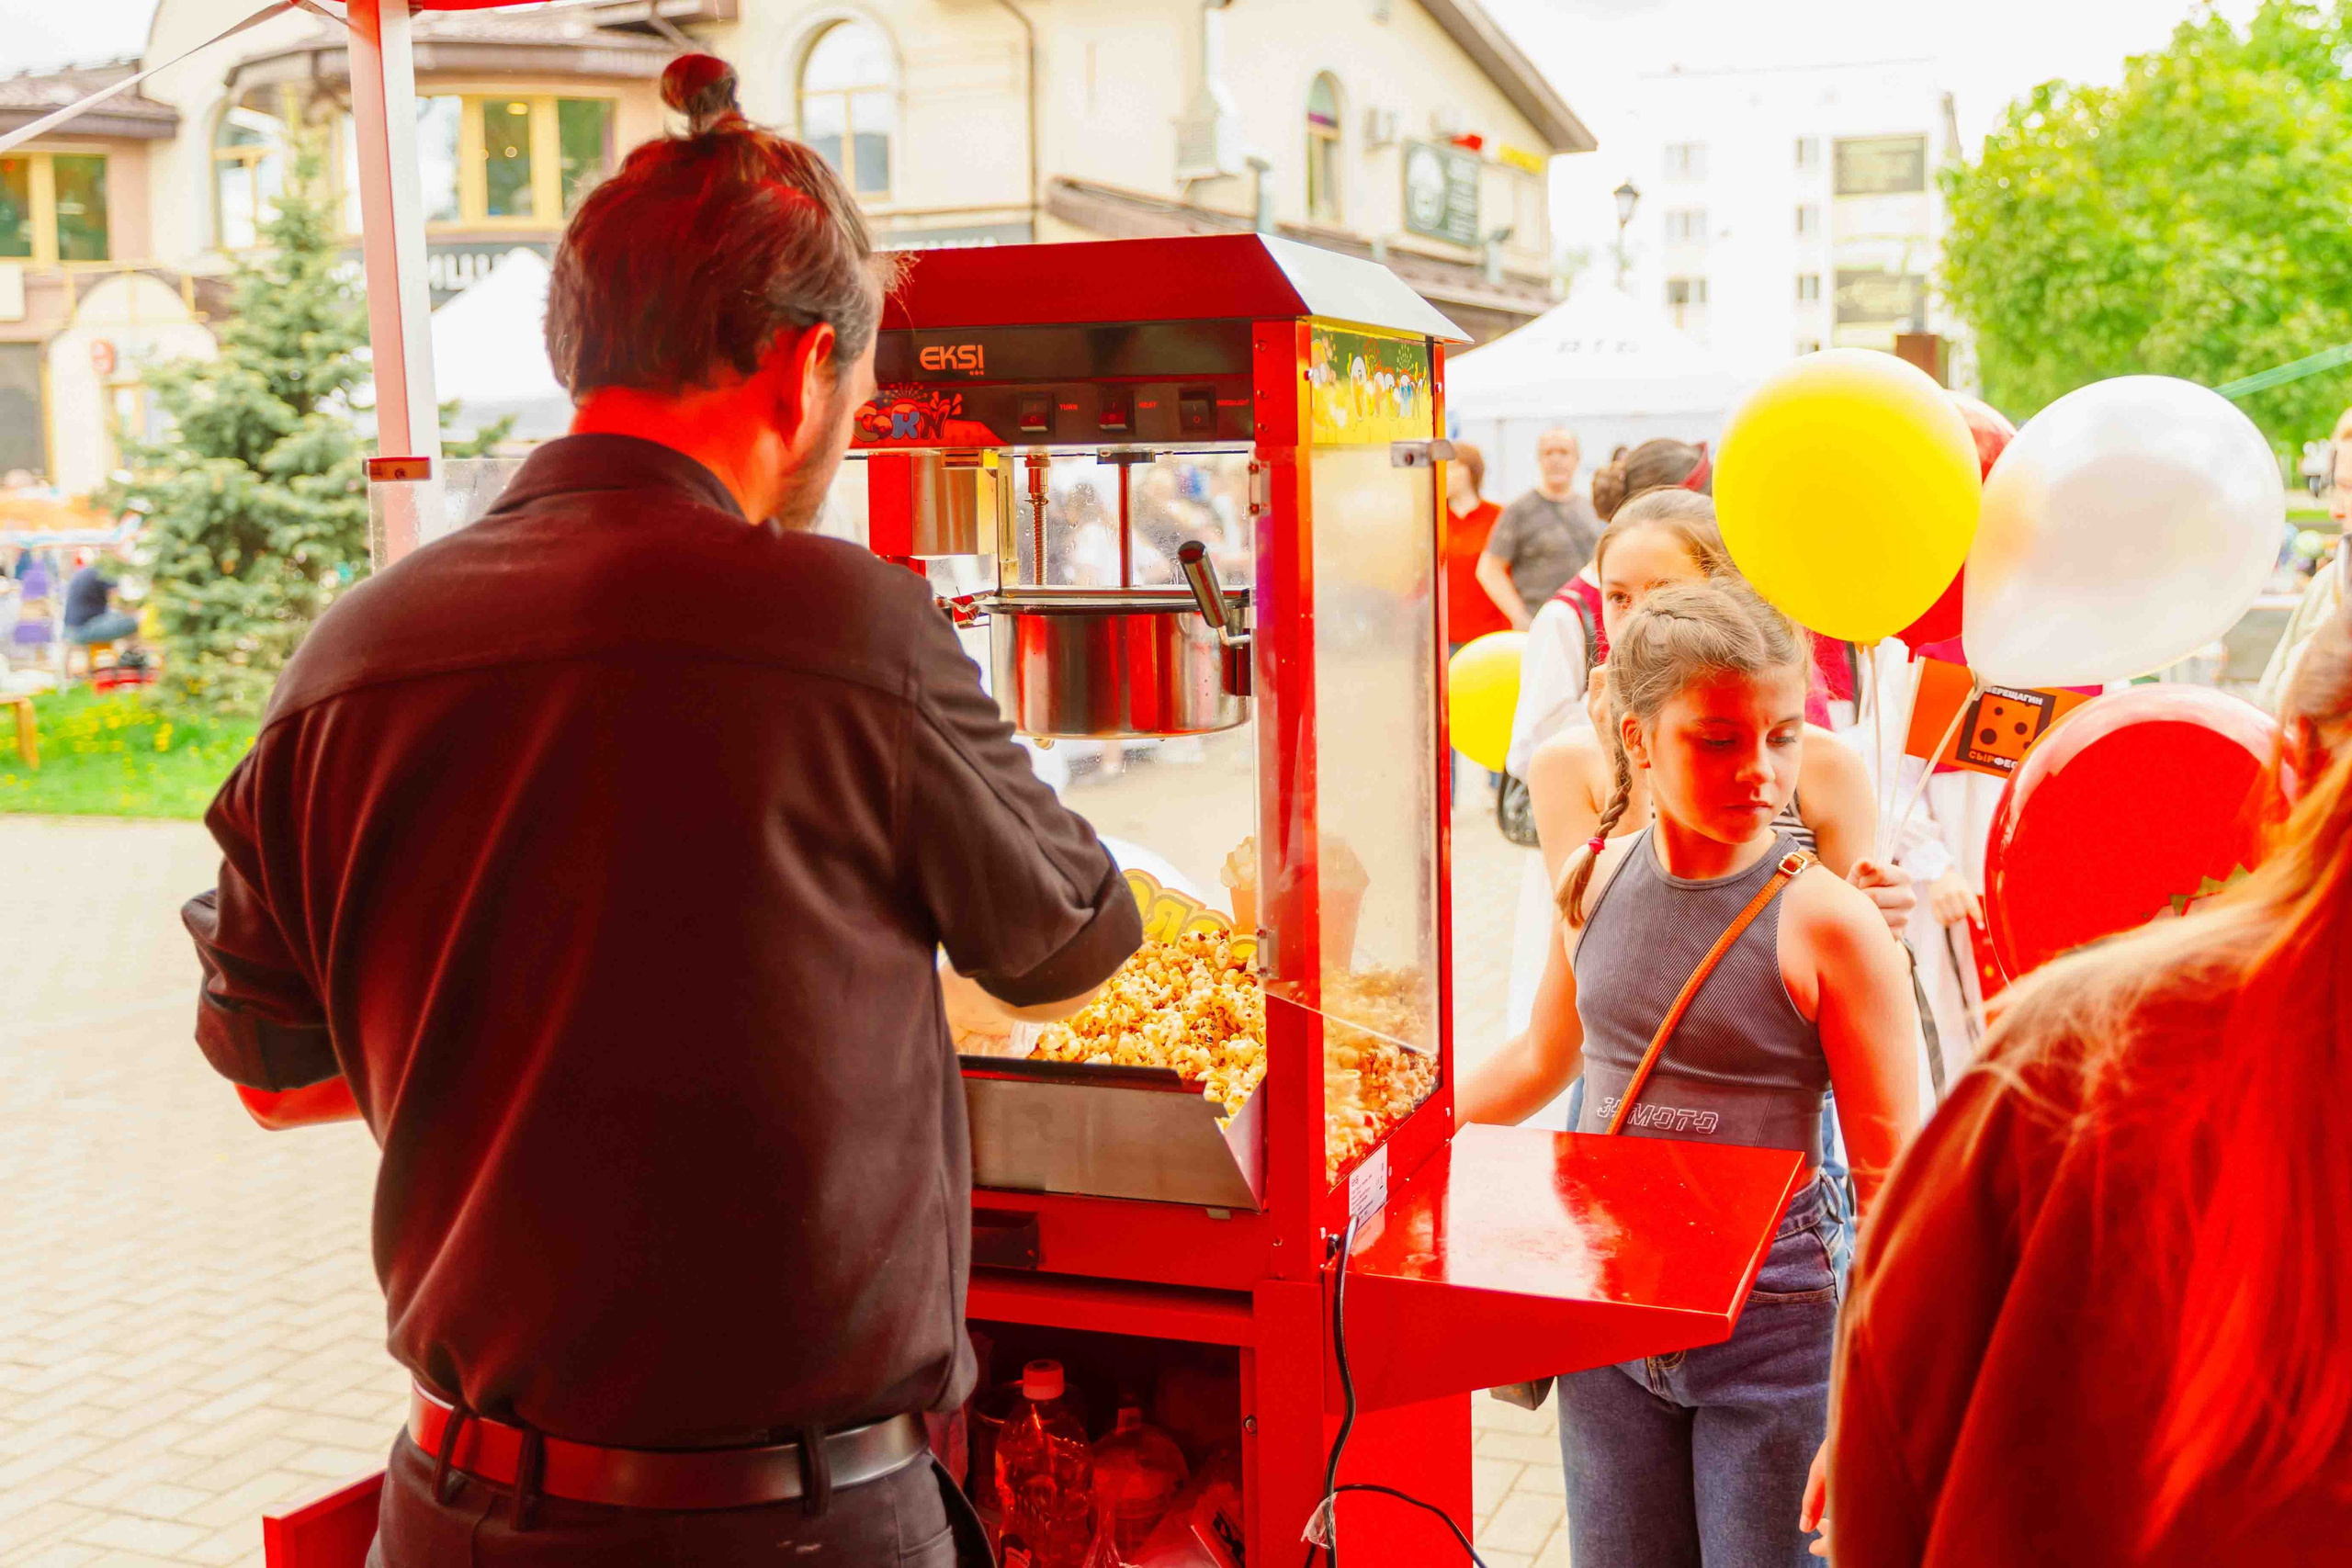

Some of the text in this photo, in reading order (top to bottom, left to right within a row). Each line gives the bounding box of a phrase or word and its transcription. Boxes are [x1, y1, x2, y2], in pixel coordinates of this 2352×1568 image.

[920, 344, 985, 371] EKSI
[1058, 403, 1079, 412] TURN
[1138, 400, 1158, 410] HEAT
